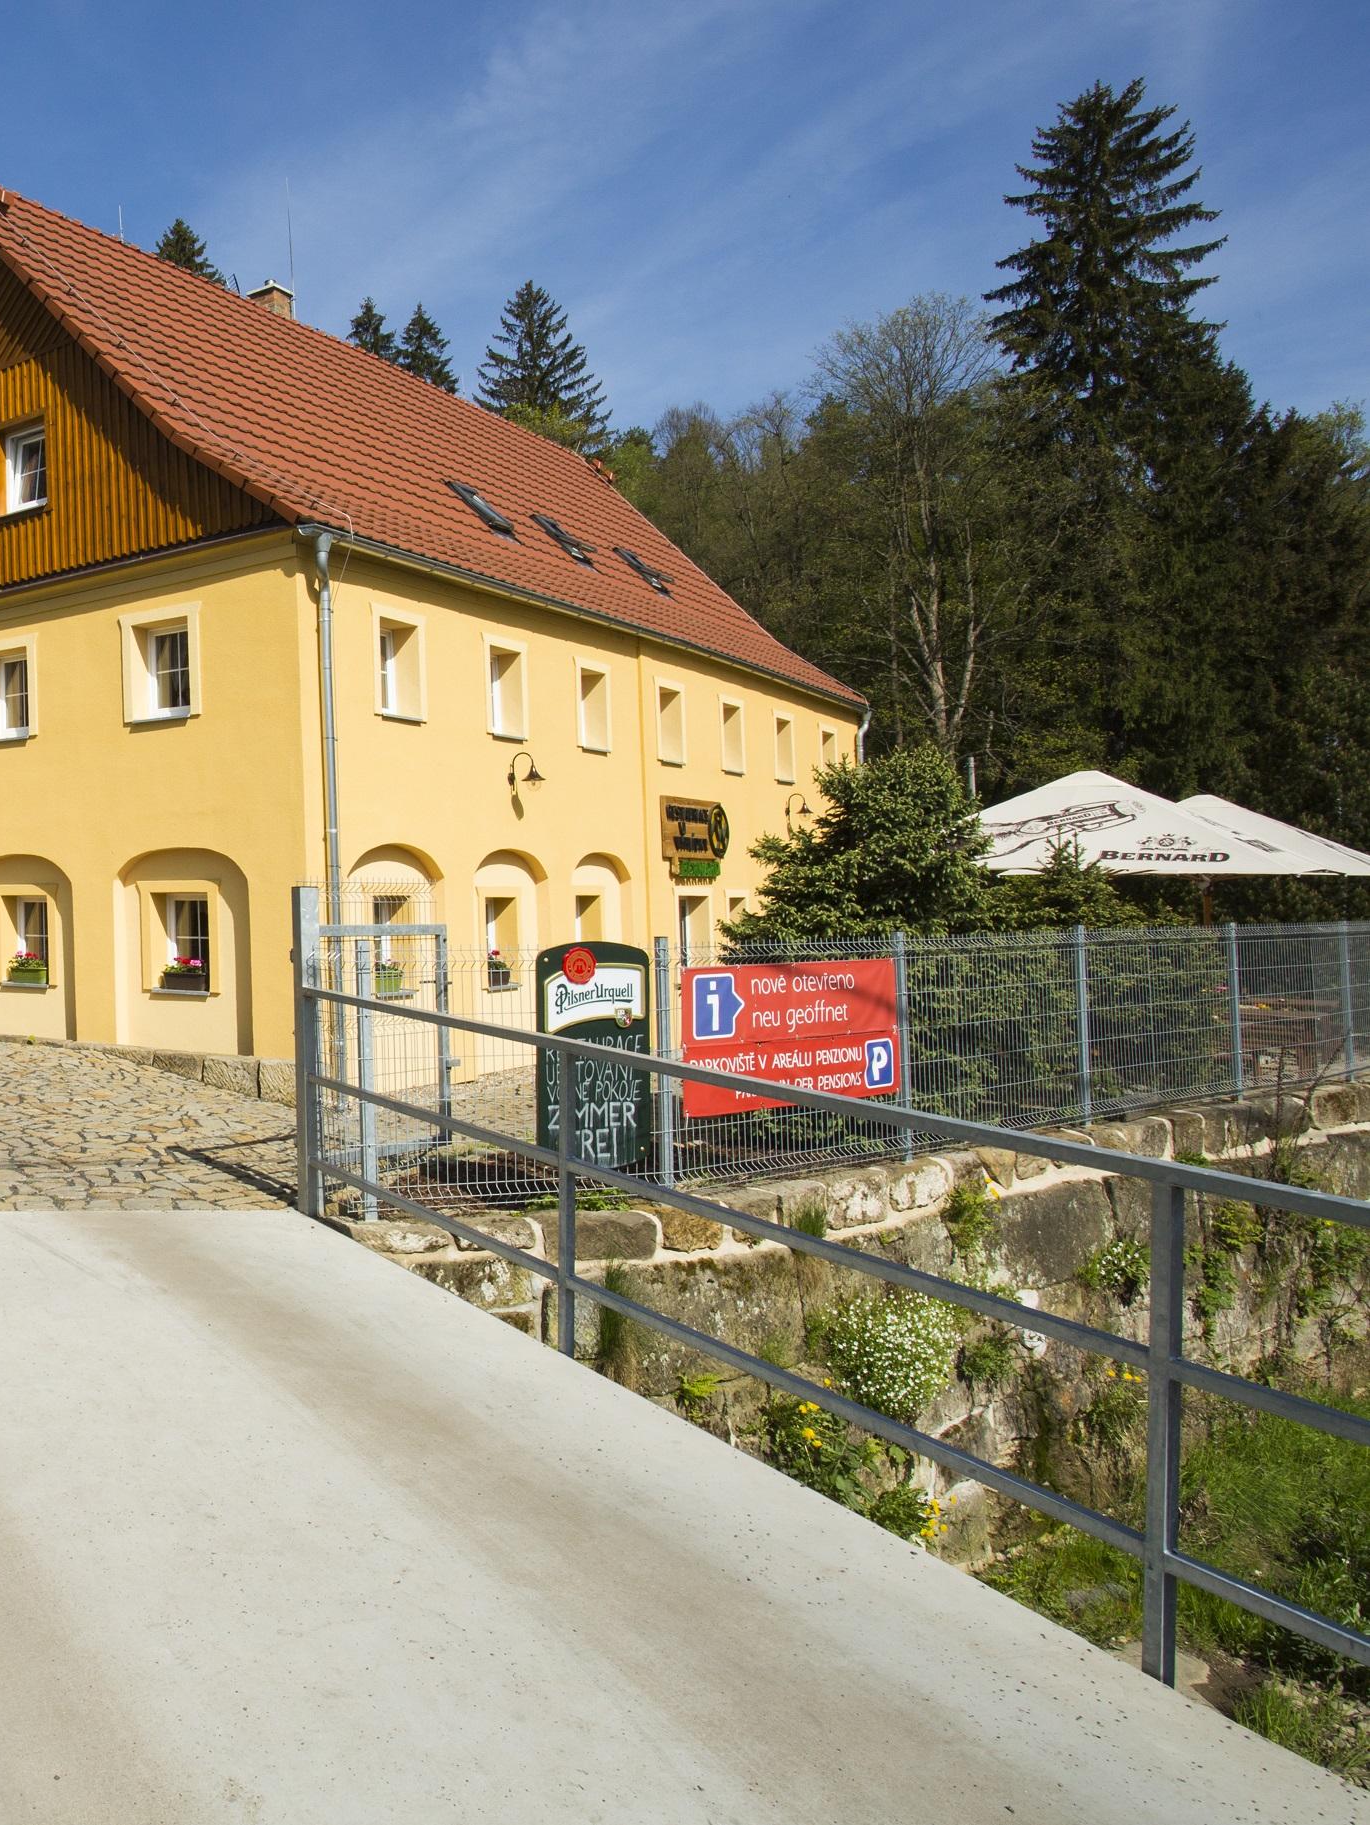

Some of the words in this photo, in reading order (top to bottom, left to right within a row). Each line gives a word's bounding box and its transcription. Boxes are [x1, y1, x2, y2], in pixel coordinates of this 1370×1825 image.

[1100, 850, 1230, 863] BERNARD
[792, 972, 855, 993] otevřeno
[555, 983, 595, 1015] Pilsner
[594, 982, 633, 1005] Urquell
[752, 1010, 781, 1028] neu
[786, 1000, 848, 1033] geöffnet
[758, 1054, 768, 1070] V
[772, 1049, 812, 1069] AREÁLU
[816, 1046, 863, 1066] PENZIONU
[595, 1080, 643, 1101] POKOJE
[818, 1071, 863, 1091] PENSIONS
[548, 1101, 638, 1130] ZMMER
[575, 1127, 617, 1161] REI
